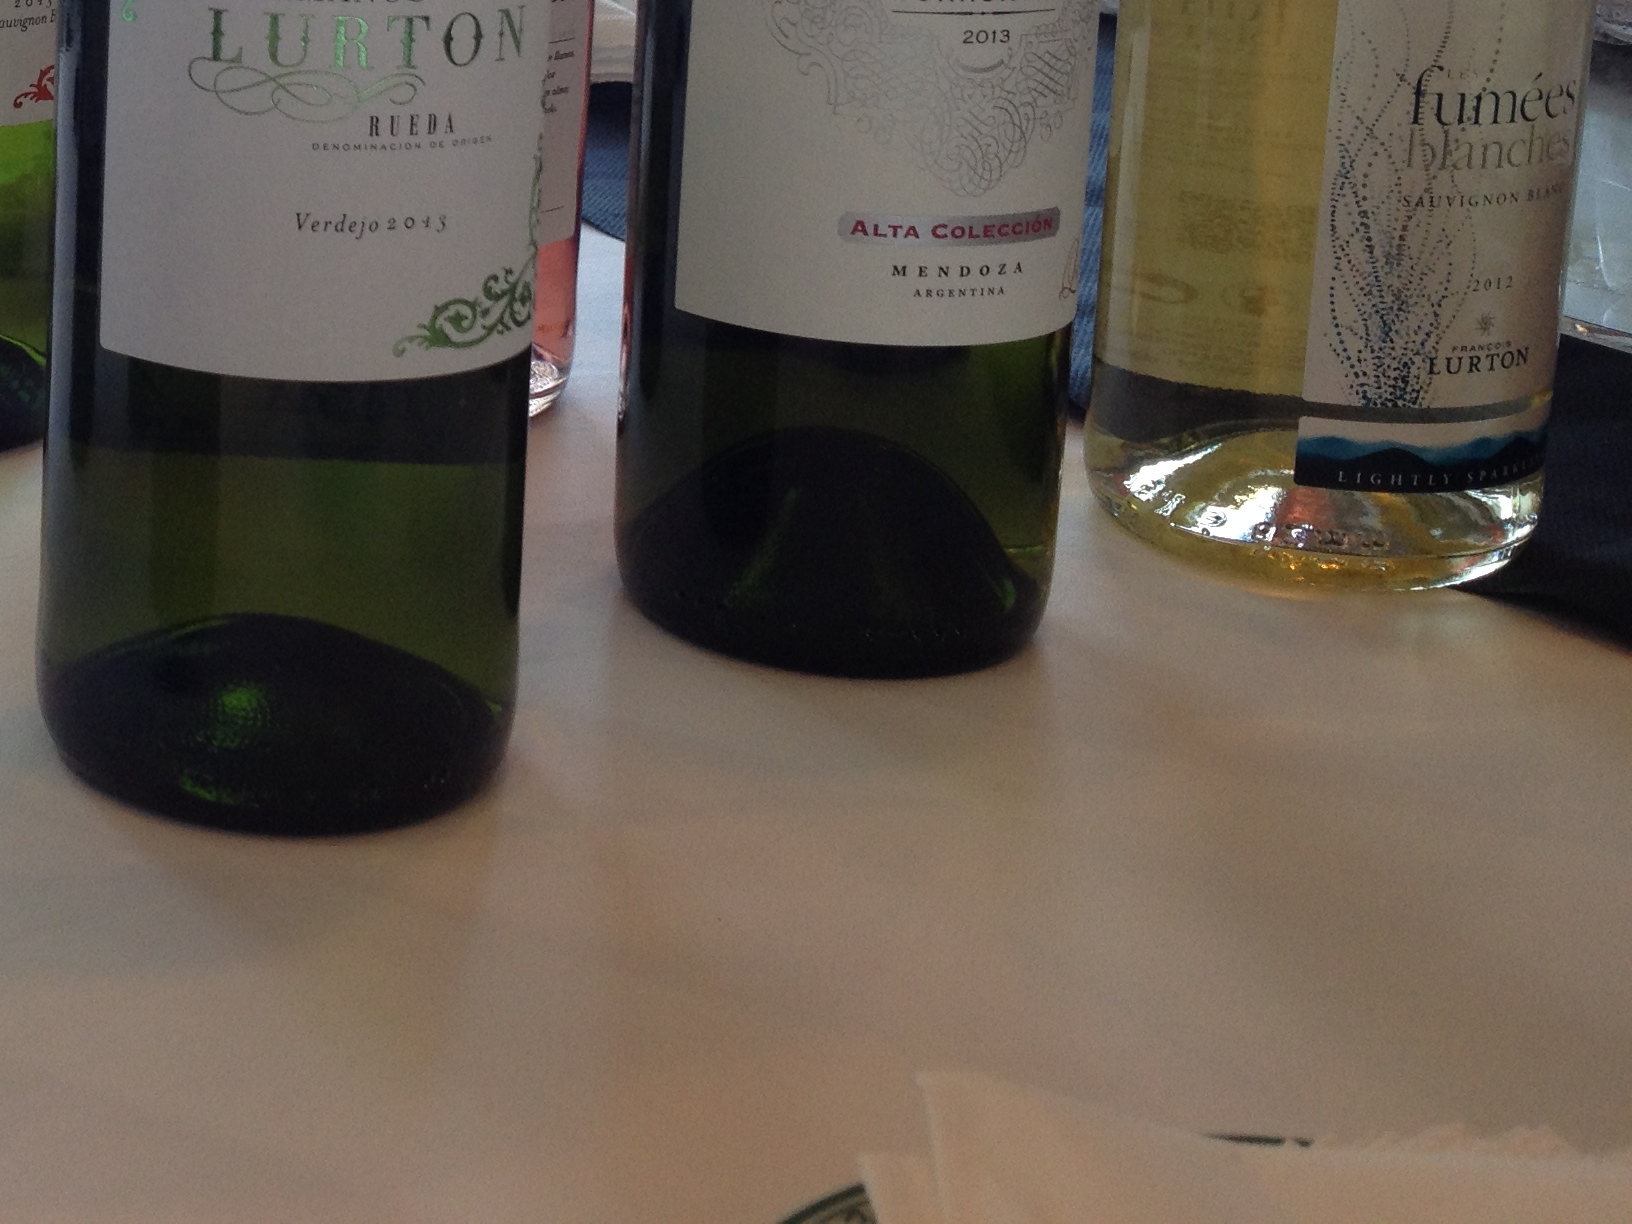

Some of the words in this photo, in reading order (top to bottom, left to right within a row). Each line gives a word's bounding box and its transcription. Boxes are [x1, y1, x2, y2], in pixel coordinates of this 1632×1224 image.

[208, 6, 526, 70] LURTON
[962, 29, 1011, 45] 2013
[1411, 65, 1576, 126] fumées
[369, 112, 455, 137] RUEDA
[429, 140, 445, 149] DE
[1407, 123, 1571, 171] blanches
[1402, 192, 1519, 208] SAUVIGNON
[295, 212, 380, 240] Verdejo
[386, 213, 448, 234] 2013
[891, 262, 1024, 277] MENDOZA
[913, 286, 1005, 298] ARGENTINA
[1472, 276, 1513, 292] 2012
[1428, 347, 1530, 375] LURTON
[1338, 471, 1453, 487] LIGHTLY
